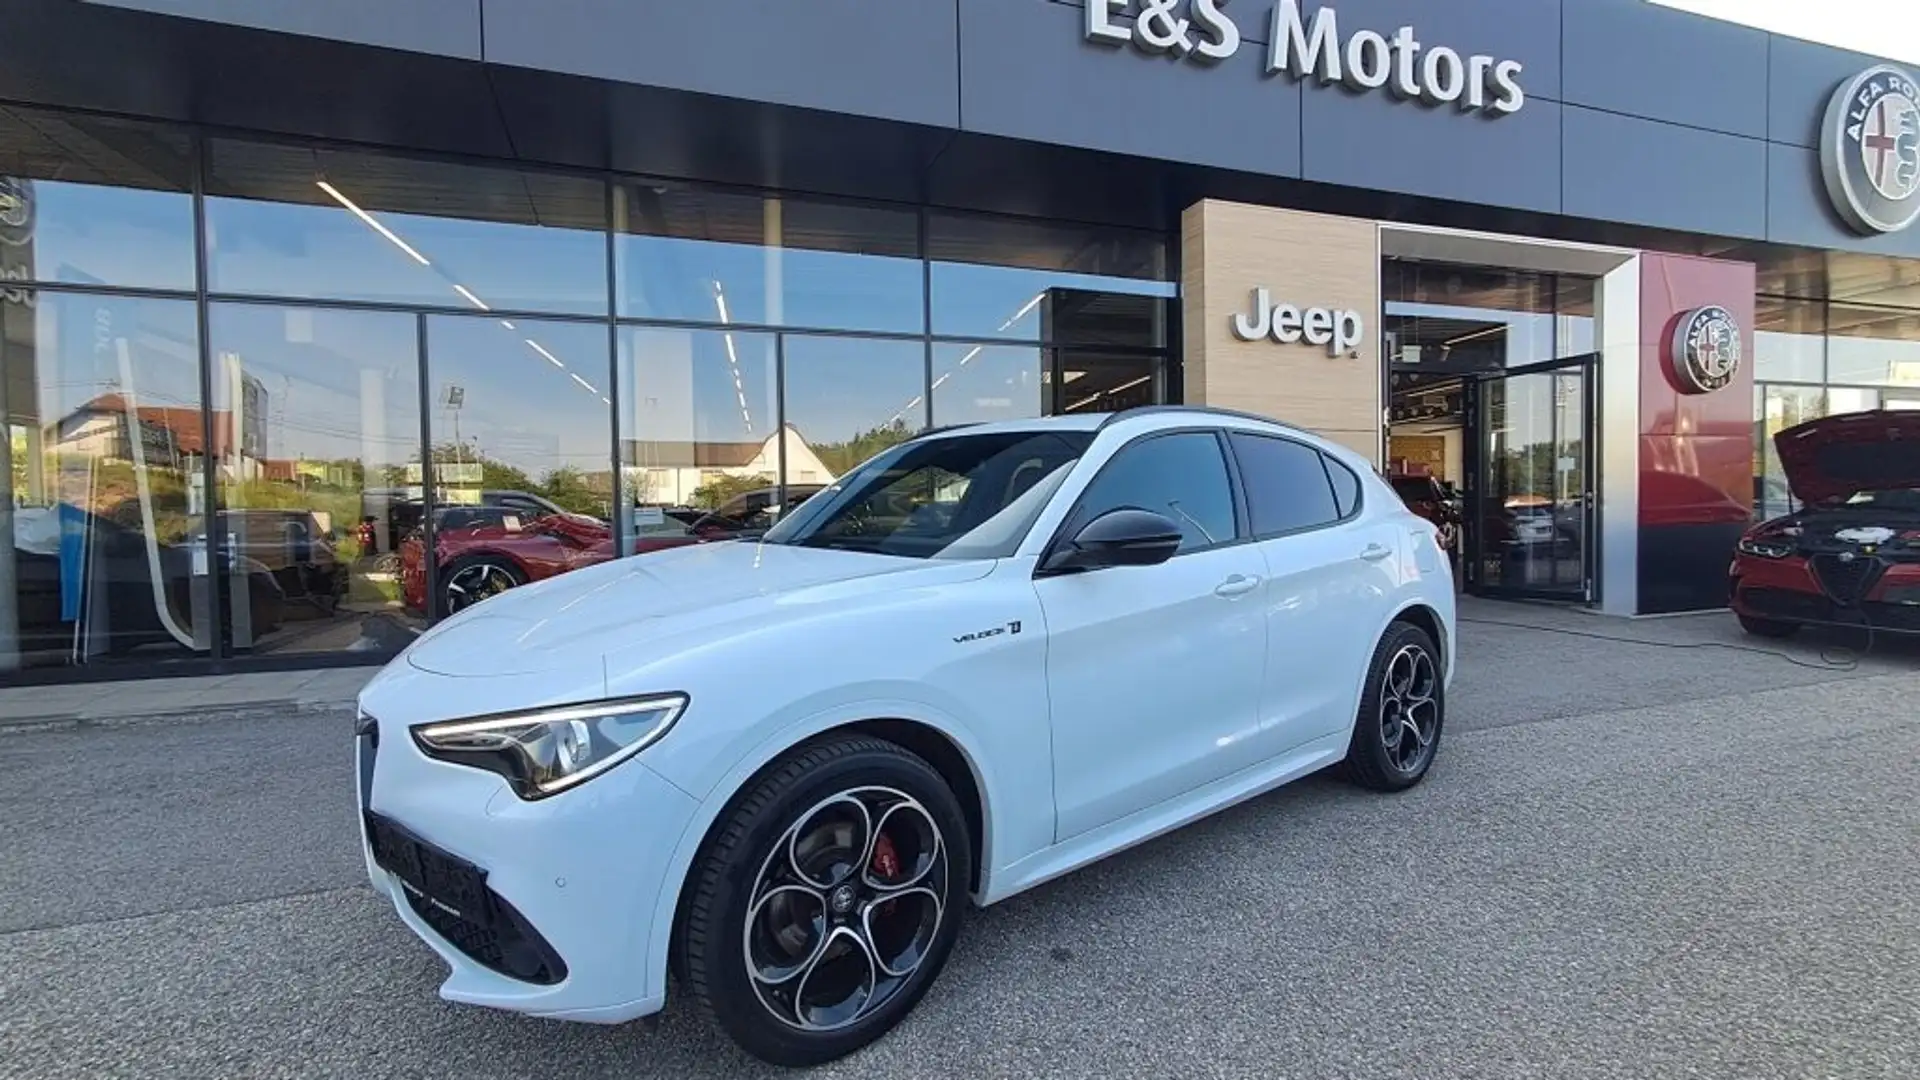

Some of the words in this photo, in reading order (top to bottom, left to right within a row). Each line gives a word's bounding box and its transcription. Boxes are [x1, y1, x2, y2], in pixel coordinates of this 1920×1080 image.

[1085, 0, 1240, 58] E&S
[1268, 0, 1524, 113] Motors
[1847, 81, 1884, 142] ALFA
[1230, 287, 1363, 357] Jeep
